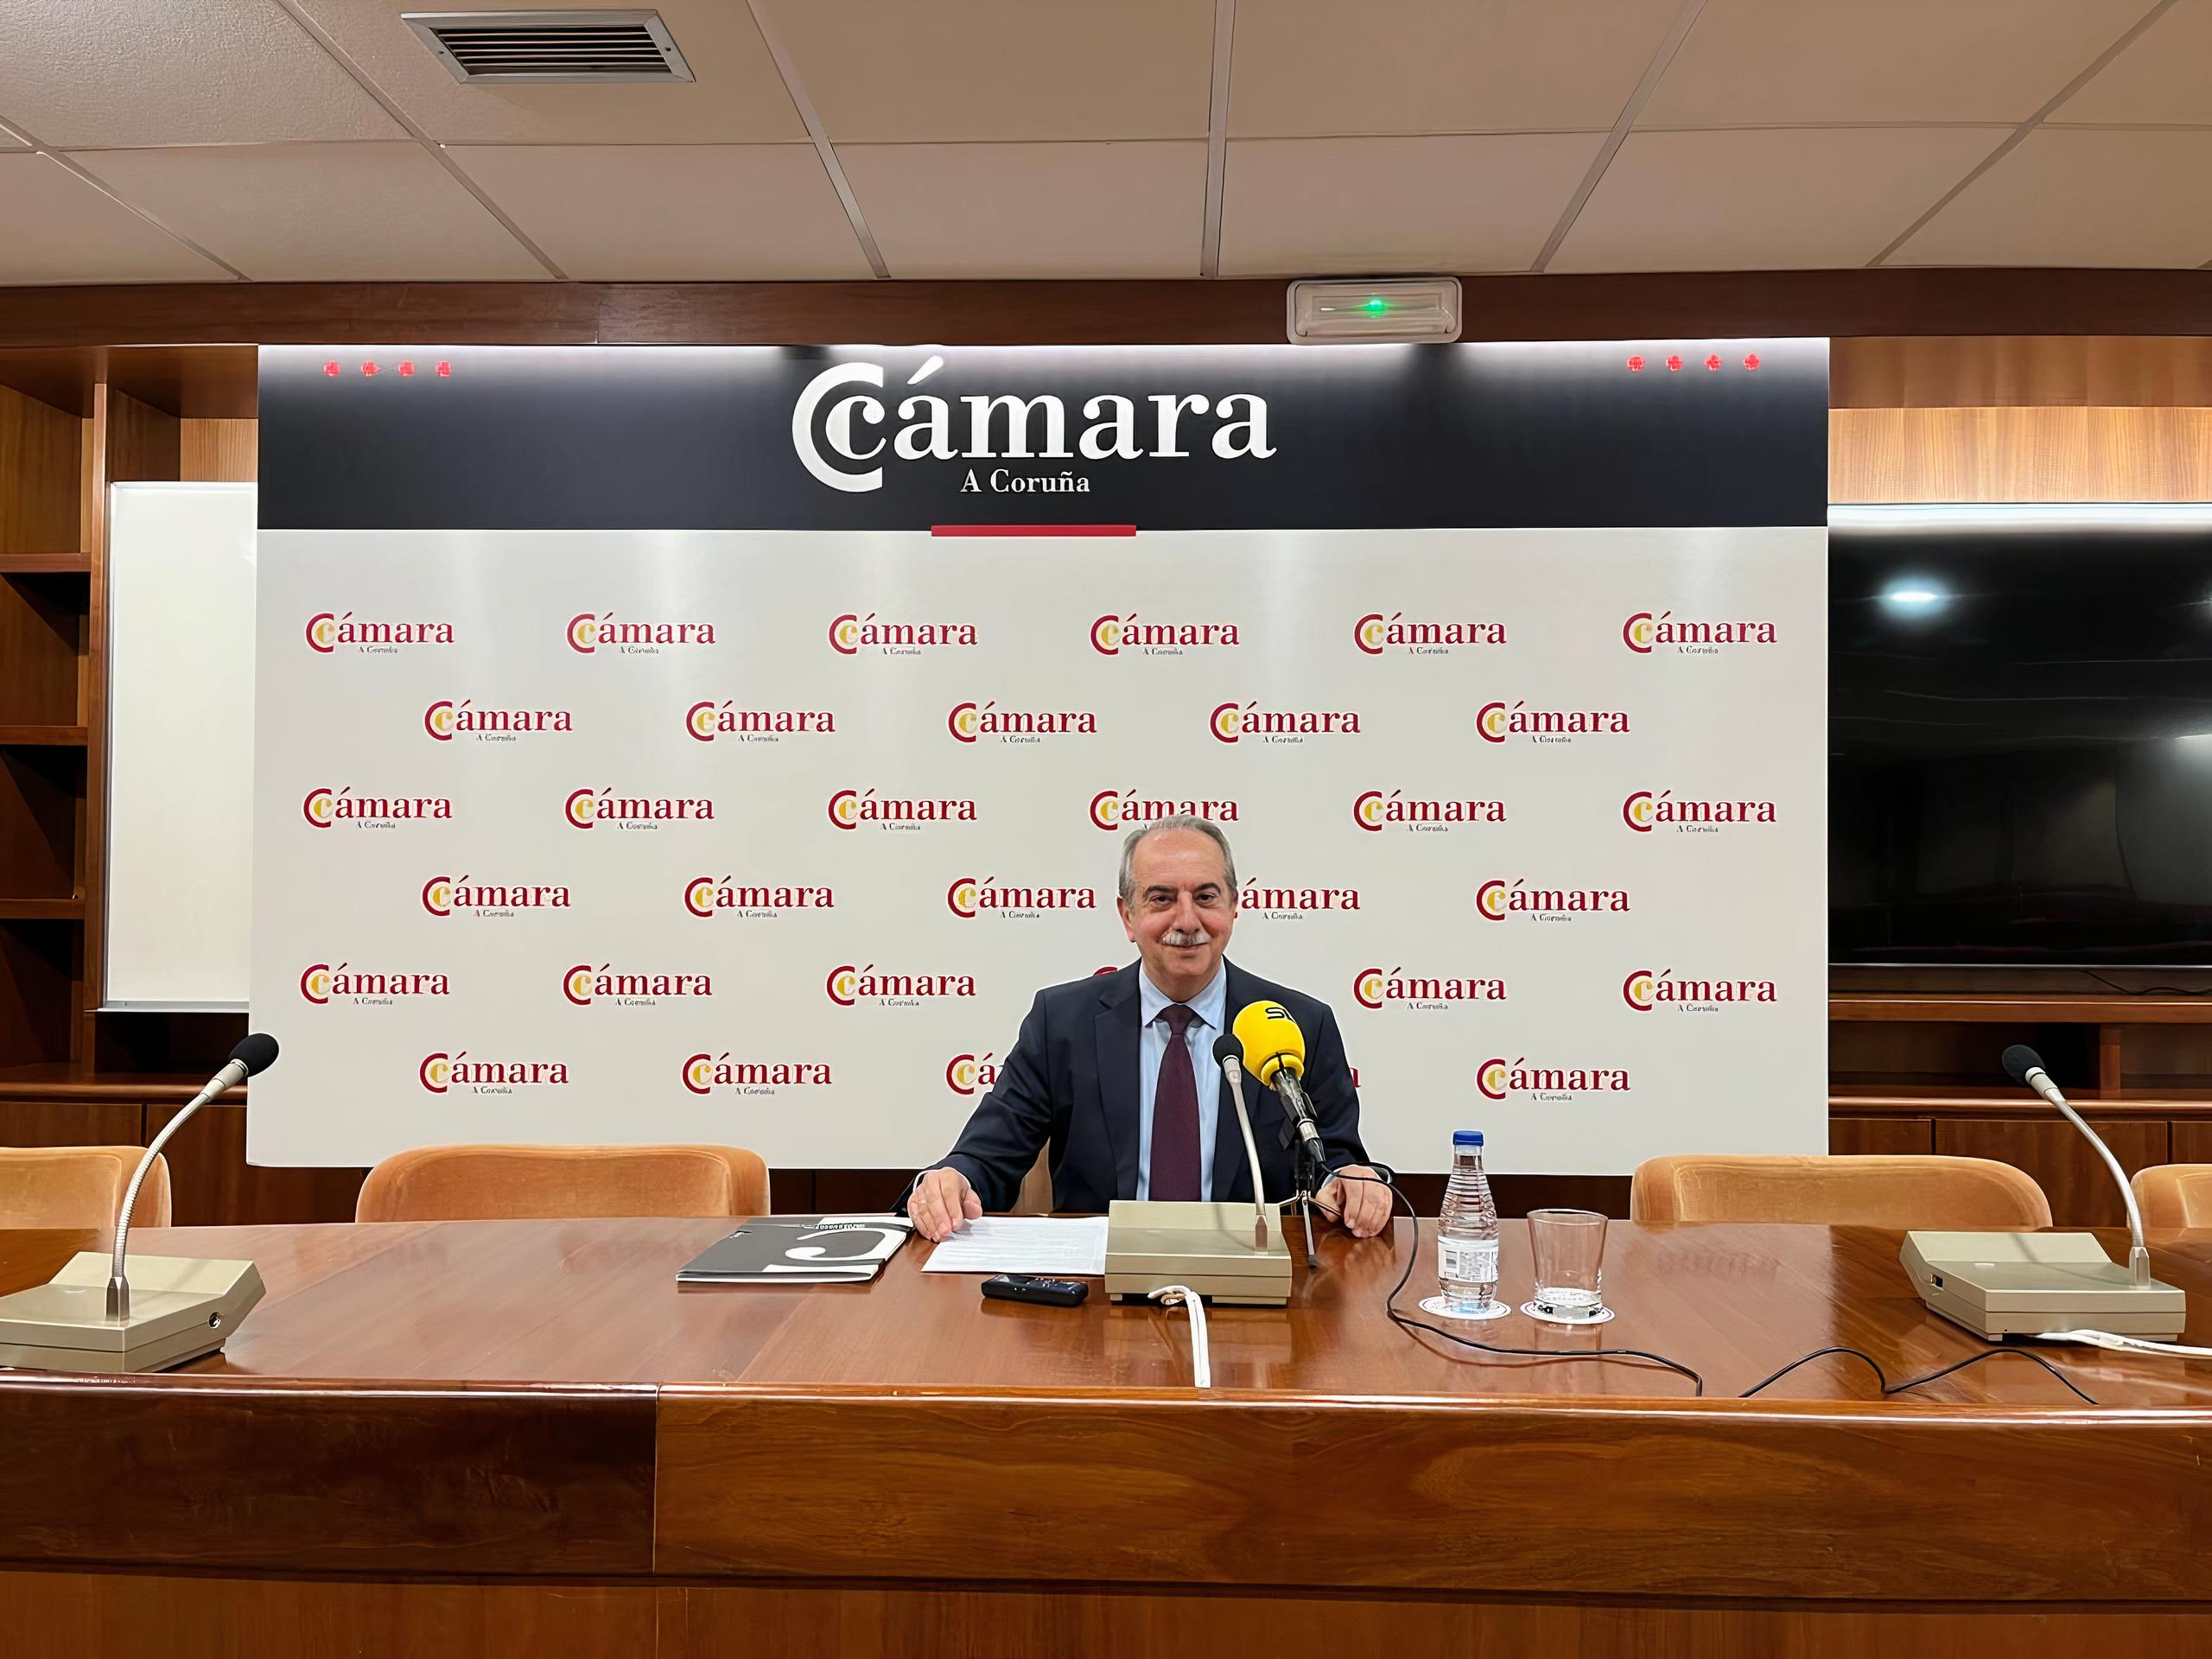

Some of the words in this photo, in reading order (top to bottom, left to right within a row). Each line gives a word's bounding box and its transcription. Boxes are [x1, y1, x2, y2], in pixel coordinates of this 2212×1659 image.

[961, 470, 982, 493] A
[990, 469, 1090, 493] Coruña
[1235, 877, 1360, 919] ámara
